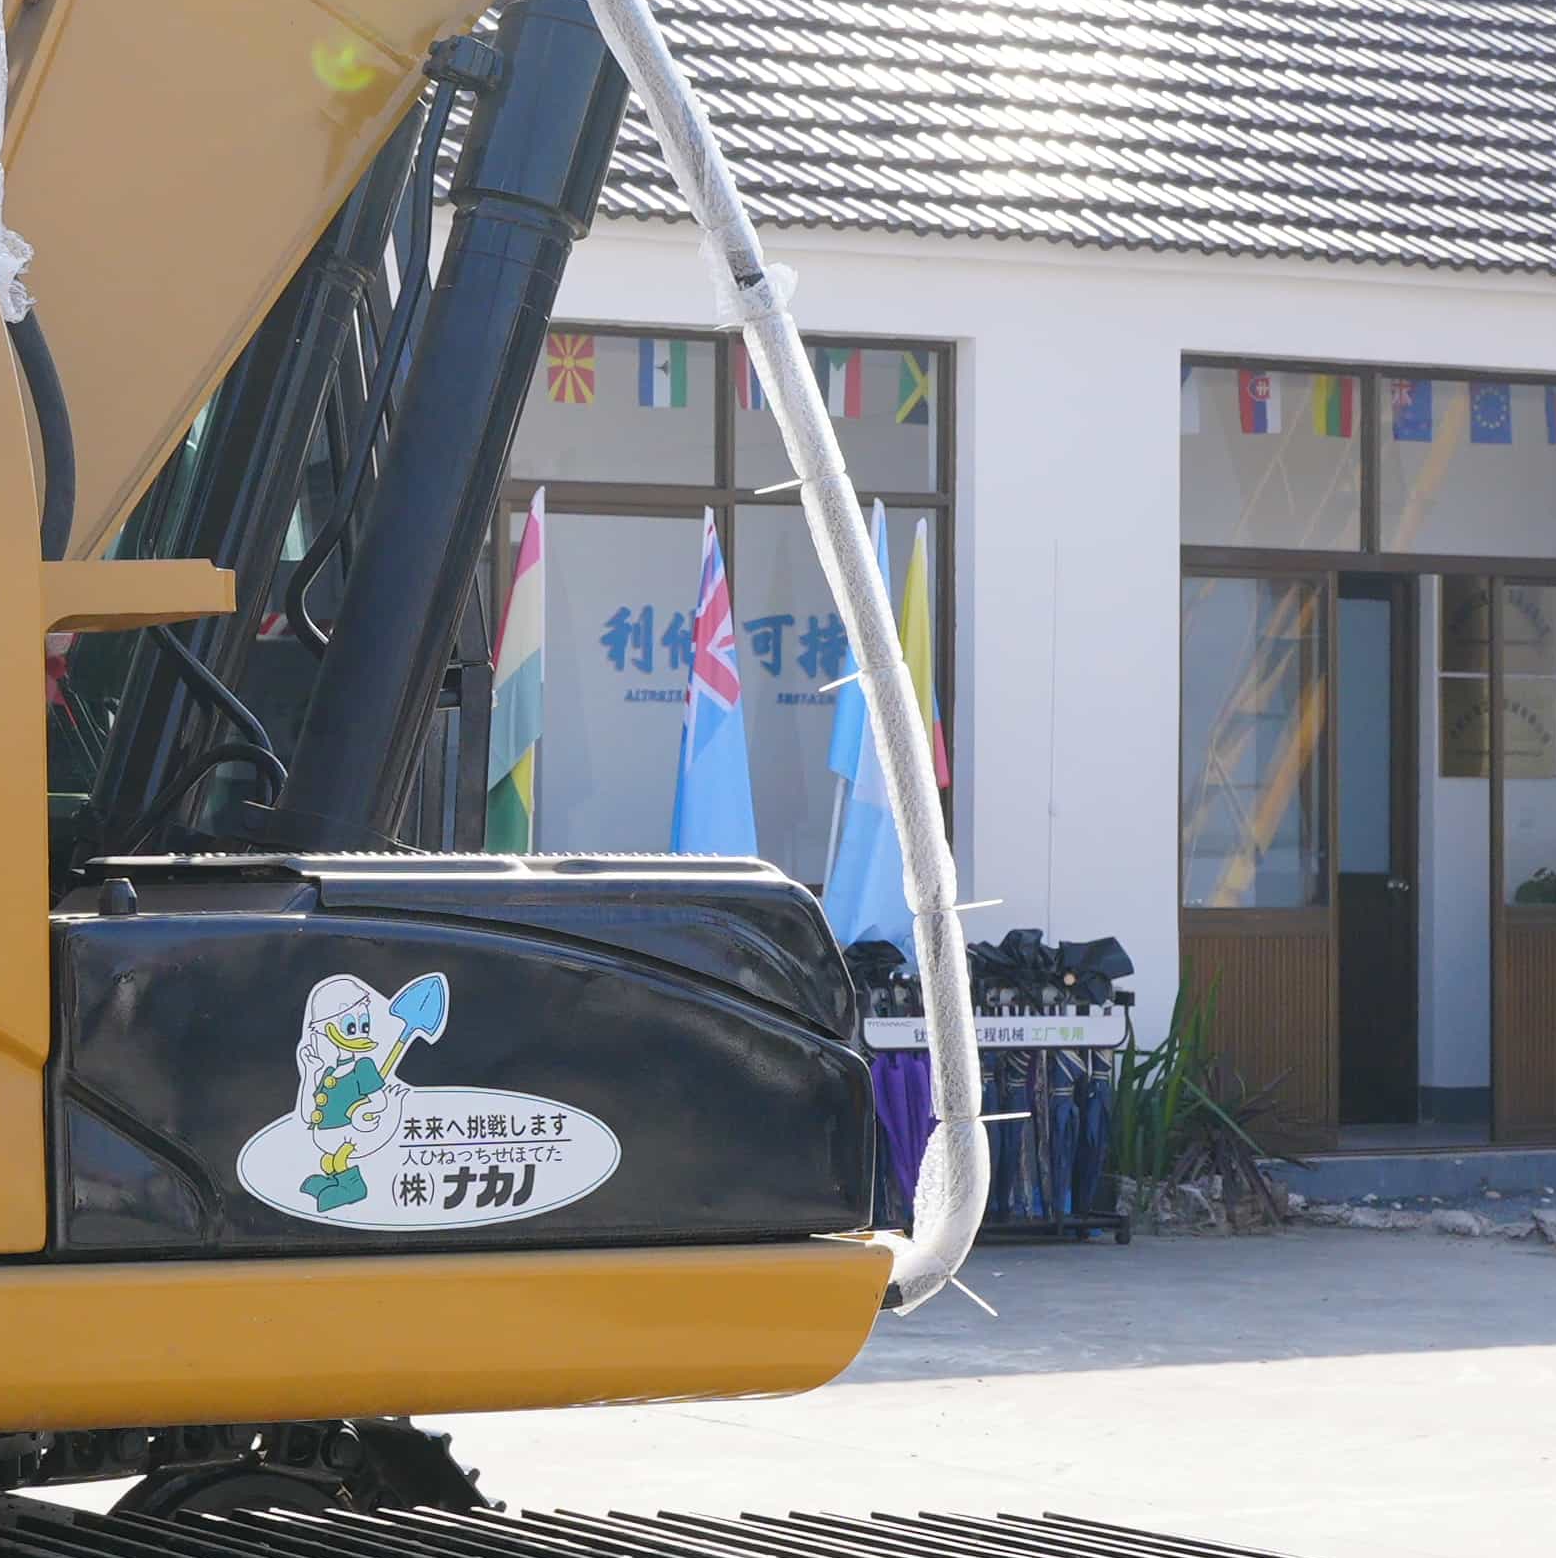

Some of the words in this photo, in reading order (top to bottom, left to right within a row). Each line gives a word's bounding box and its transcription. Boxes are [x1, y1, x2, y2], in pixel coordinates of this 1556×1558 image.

[403, 1112, 568, 1141] 未来へ挑戦します
